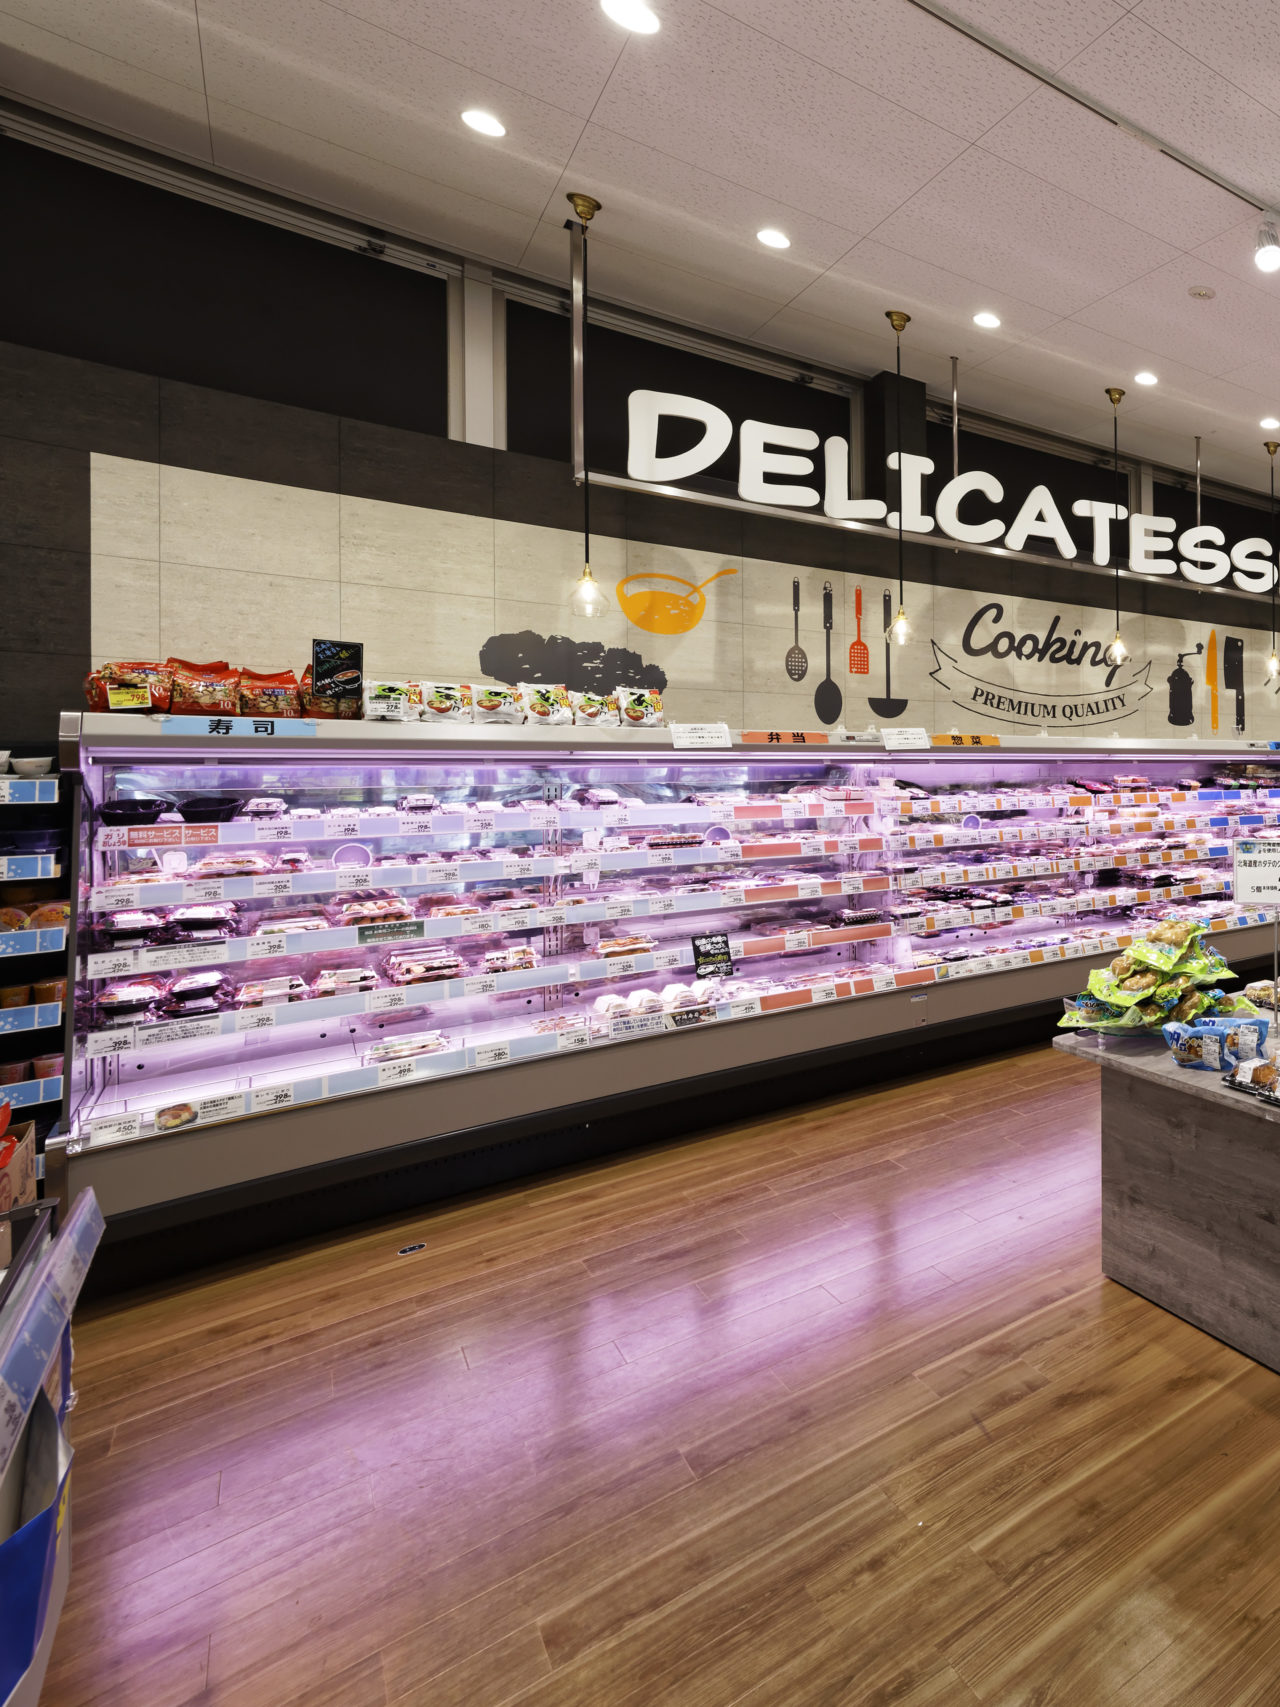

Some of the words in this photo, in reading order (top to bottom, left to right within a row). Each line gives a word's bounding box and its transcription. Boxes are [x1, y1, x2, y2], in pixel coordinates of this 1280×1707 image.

[962, 602, 1126, 688] Cooking
[971, 686, 1057, 719] PREMIUM
[1061, 693, 1128, 721] QUALITY
[208, 718, 275, 736] 寿司
[767, 732, 806, 743] 弁当
